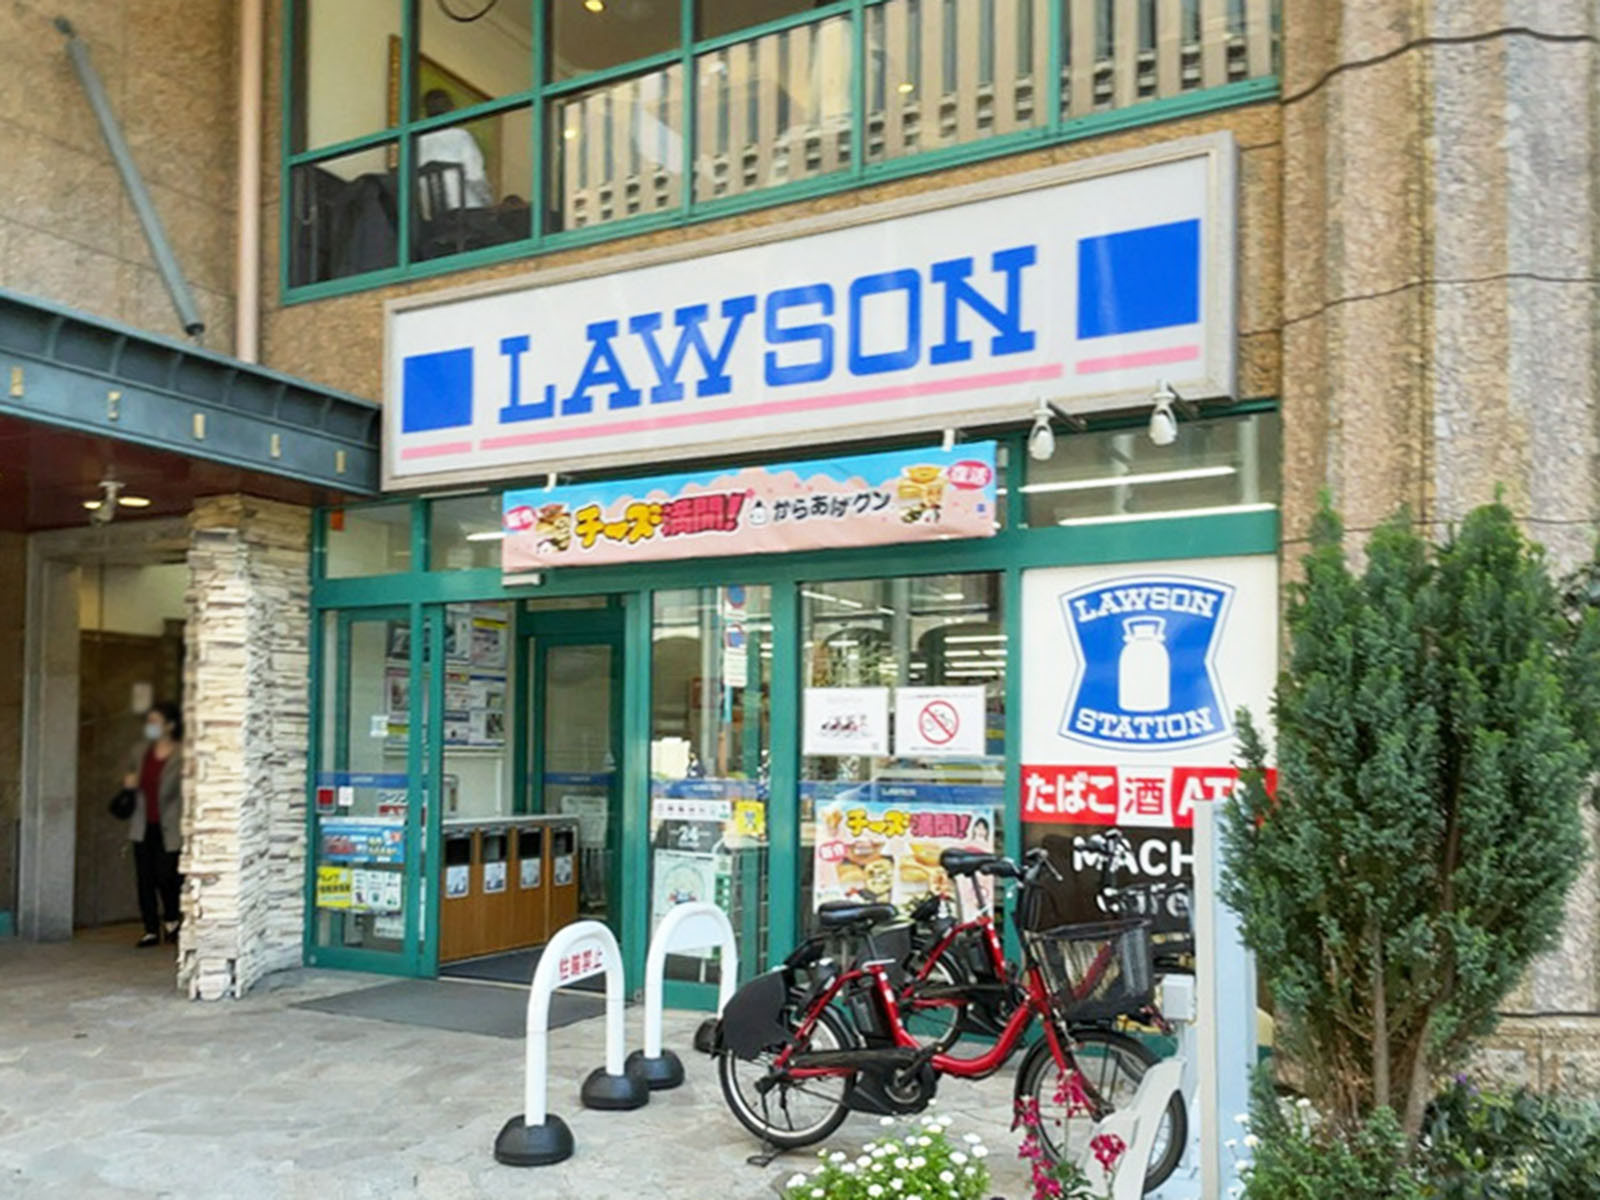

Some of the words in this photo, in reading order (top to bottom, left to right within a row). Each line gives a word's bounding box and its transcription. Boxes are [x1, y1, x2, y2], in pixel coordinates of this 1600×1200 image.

[499, 244, 1038, 425] LAWSON
[773, 490, 892, 521] からあげクン
[1073, 586, 1219, 623] LAWSON
[1075, 706, 1215, 740] STATION
[1025, 772, 1116, 814] たばこ
[1124, 776, 1166, 816] 酒
[1178, 775, 1252, 816] AT
